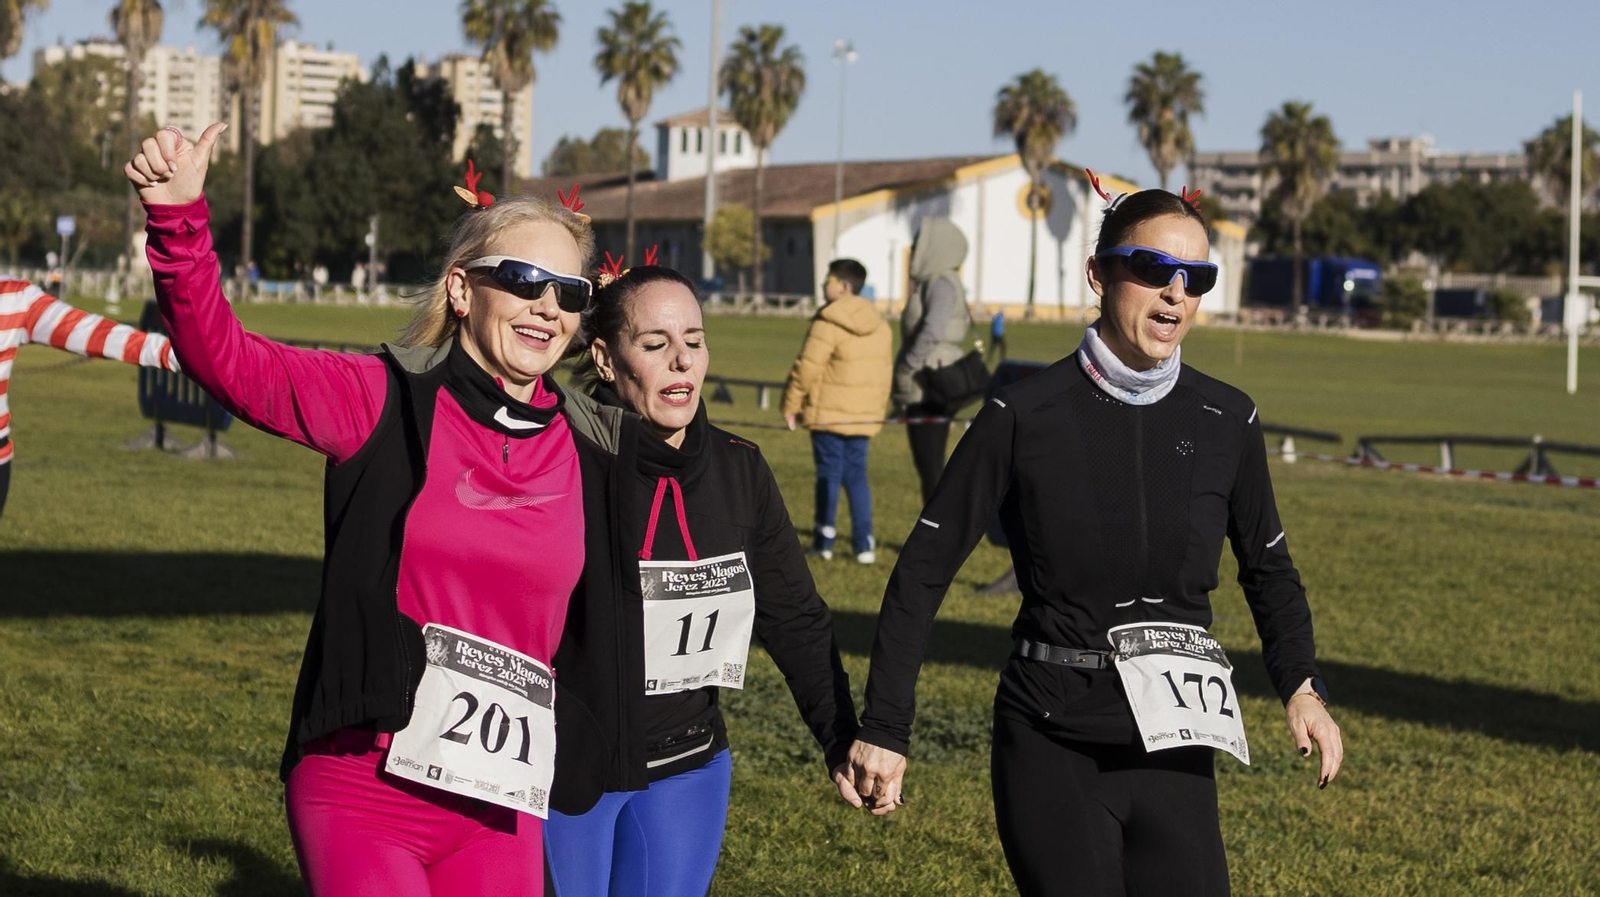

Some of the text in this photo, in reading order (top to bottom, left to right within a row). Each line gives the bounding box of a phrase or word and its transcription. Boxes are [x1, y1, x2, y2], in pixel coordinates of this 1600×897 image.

[662, 564, 746, 585] Reyes Magos
[664, 582, 698, 592] Jerez
[670, 608, 720, 657] 11
[1143, 629, 1186, 642] Reyes
[1149, 640, 1182, 650] Jerez
[455, 639, 505, 667] Reyes
[509, 658, 550, 689] Magos
[456, 655, 494, 675] Jerez
[1160, 670, 1234, 719] 172
[439, 690, 533, 767] 201
